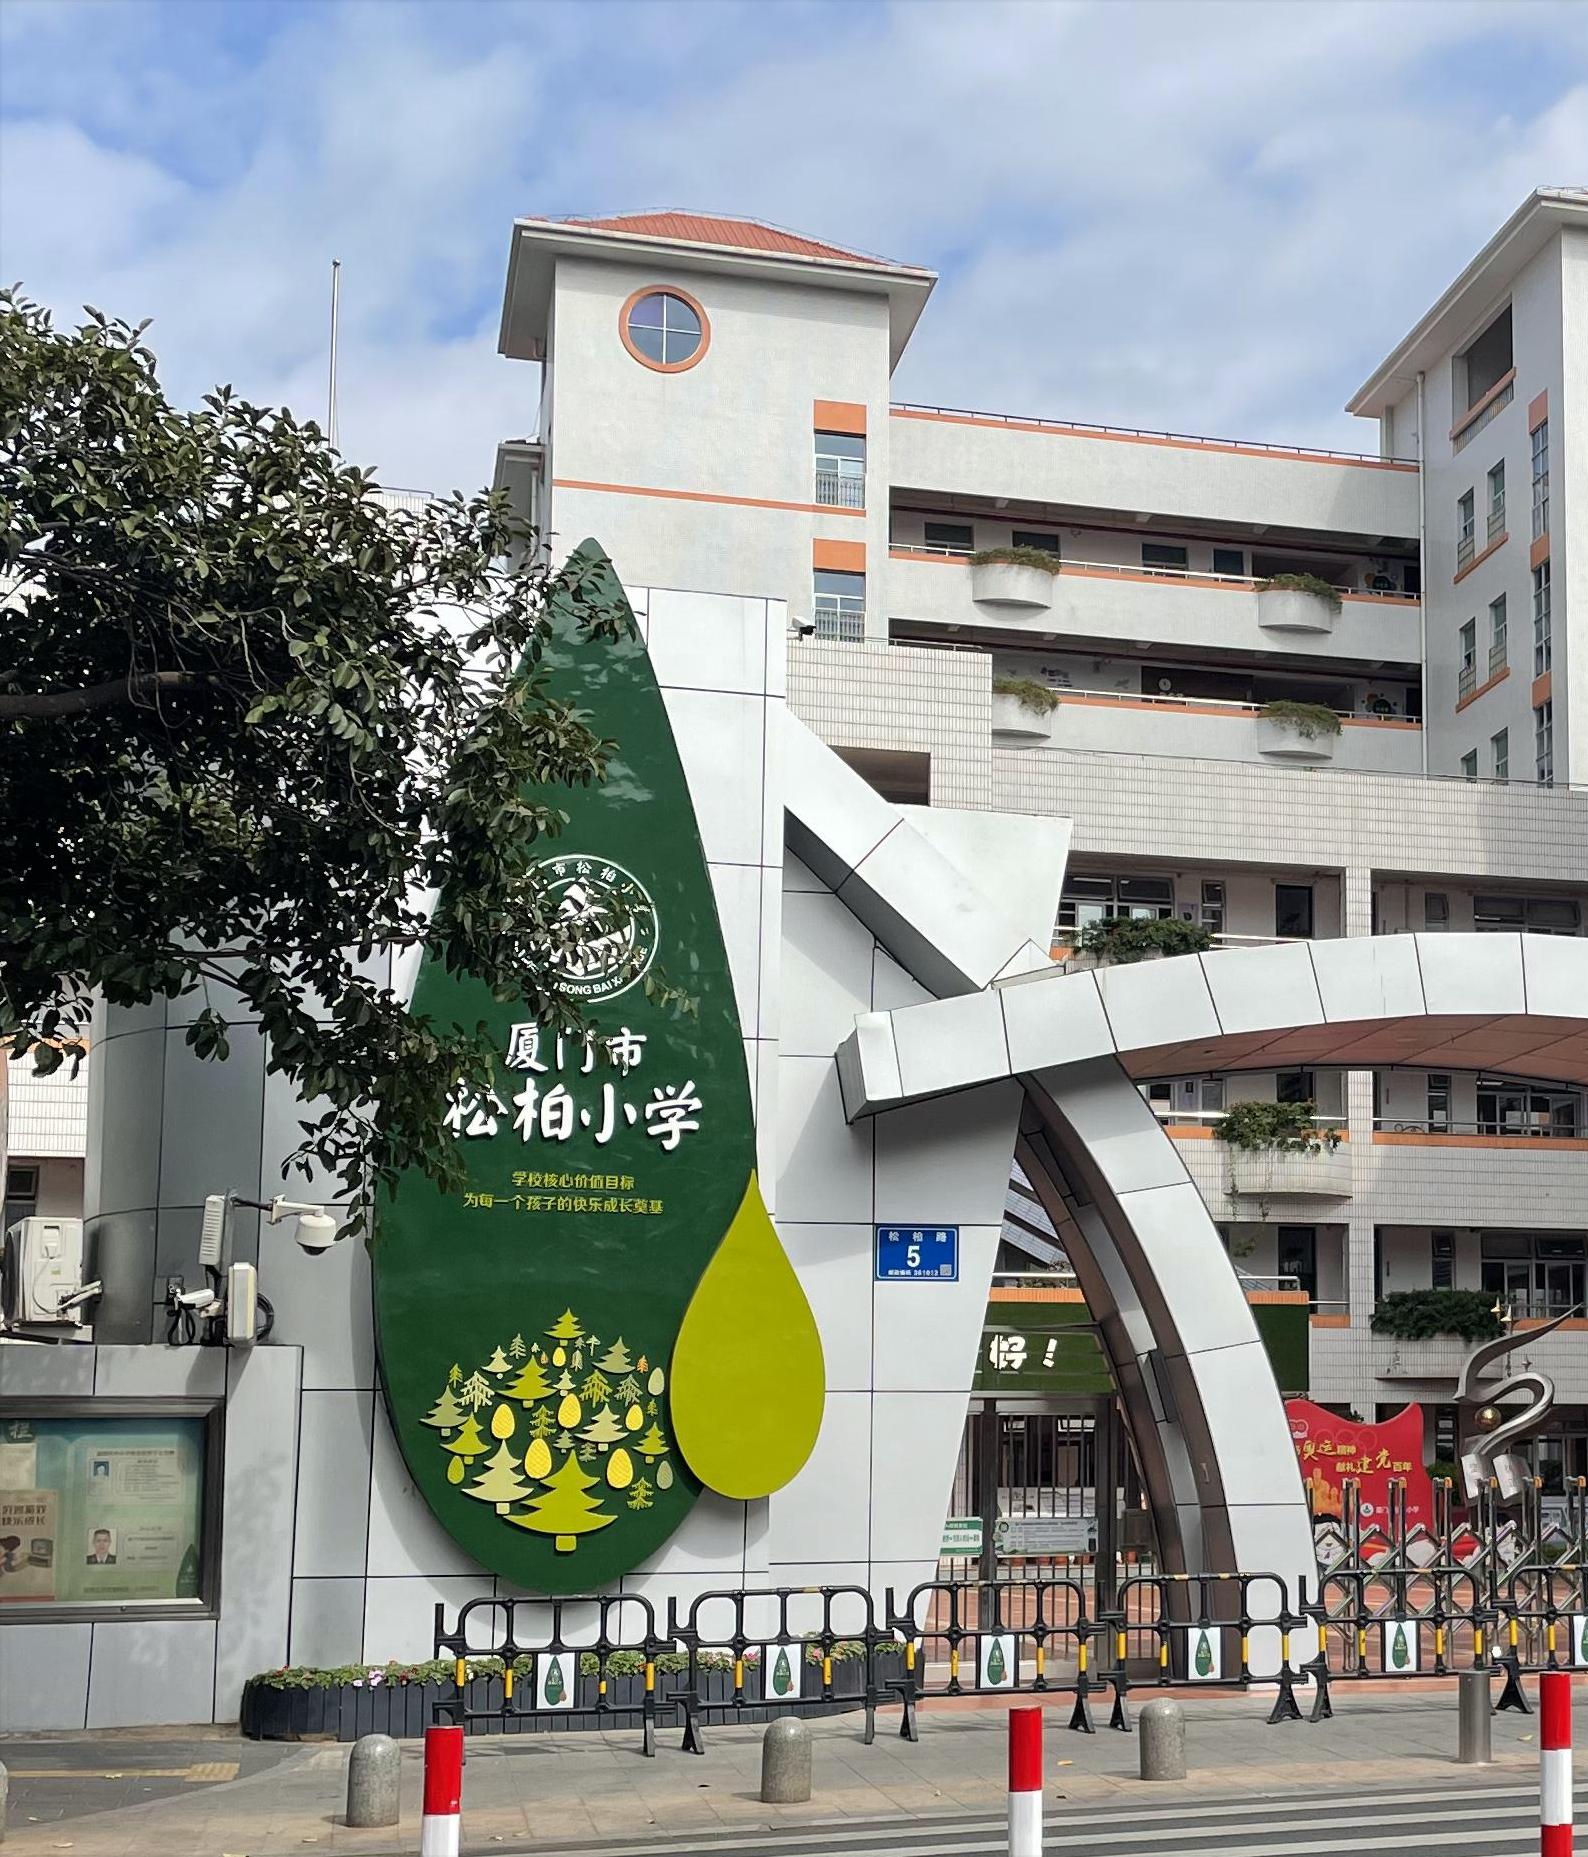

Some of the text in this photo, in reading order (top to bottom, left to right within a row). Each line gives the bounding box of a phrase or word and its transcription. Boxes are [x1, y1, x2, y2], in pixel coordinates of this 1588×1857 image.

[558, 978, 592, 995] SONG
[505, 1022, 648, 1077] 厦门市
[443, 1077, 703, 1152] 松柏小学
[512, 1170, 636, 1192] 学校核心价值目标
[463, 1192, 664, 1215] 为每一个孩子的快乐成长奠基
[906, 1245, 920, 1268] 5
